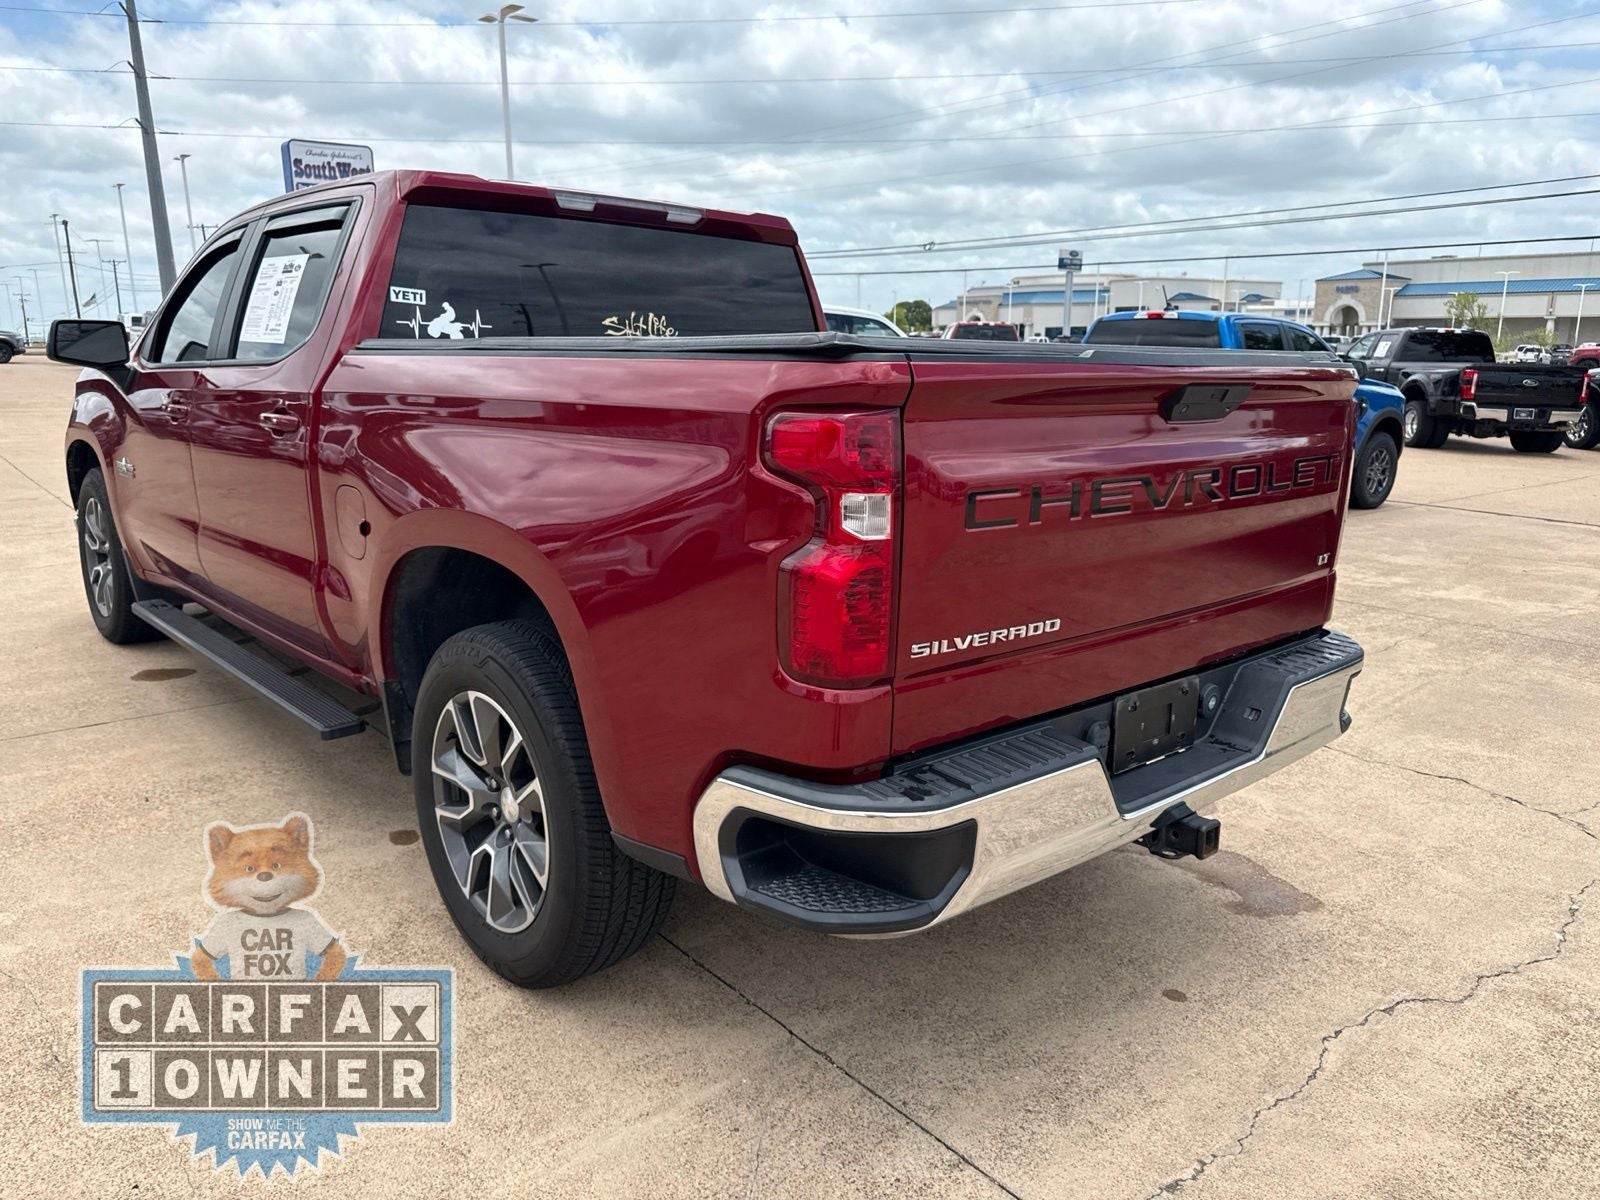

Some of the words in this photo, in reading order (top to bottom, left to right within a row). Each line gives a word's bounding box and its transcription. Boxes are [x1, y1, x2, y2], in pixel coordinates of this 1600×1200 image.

[392, 288, 423, 302] YETI
[965, 455, 1340, 531] CHEVROLET
[910, 618, 1062, 659] SILVERADO
